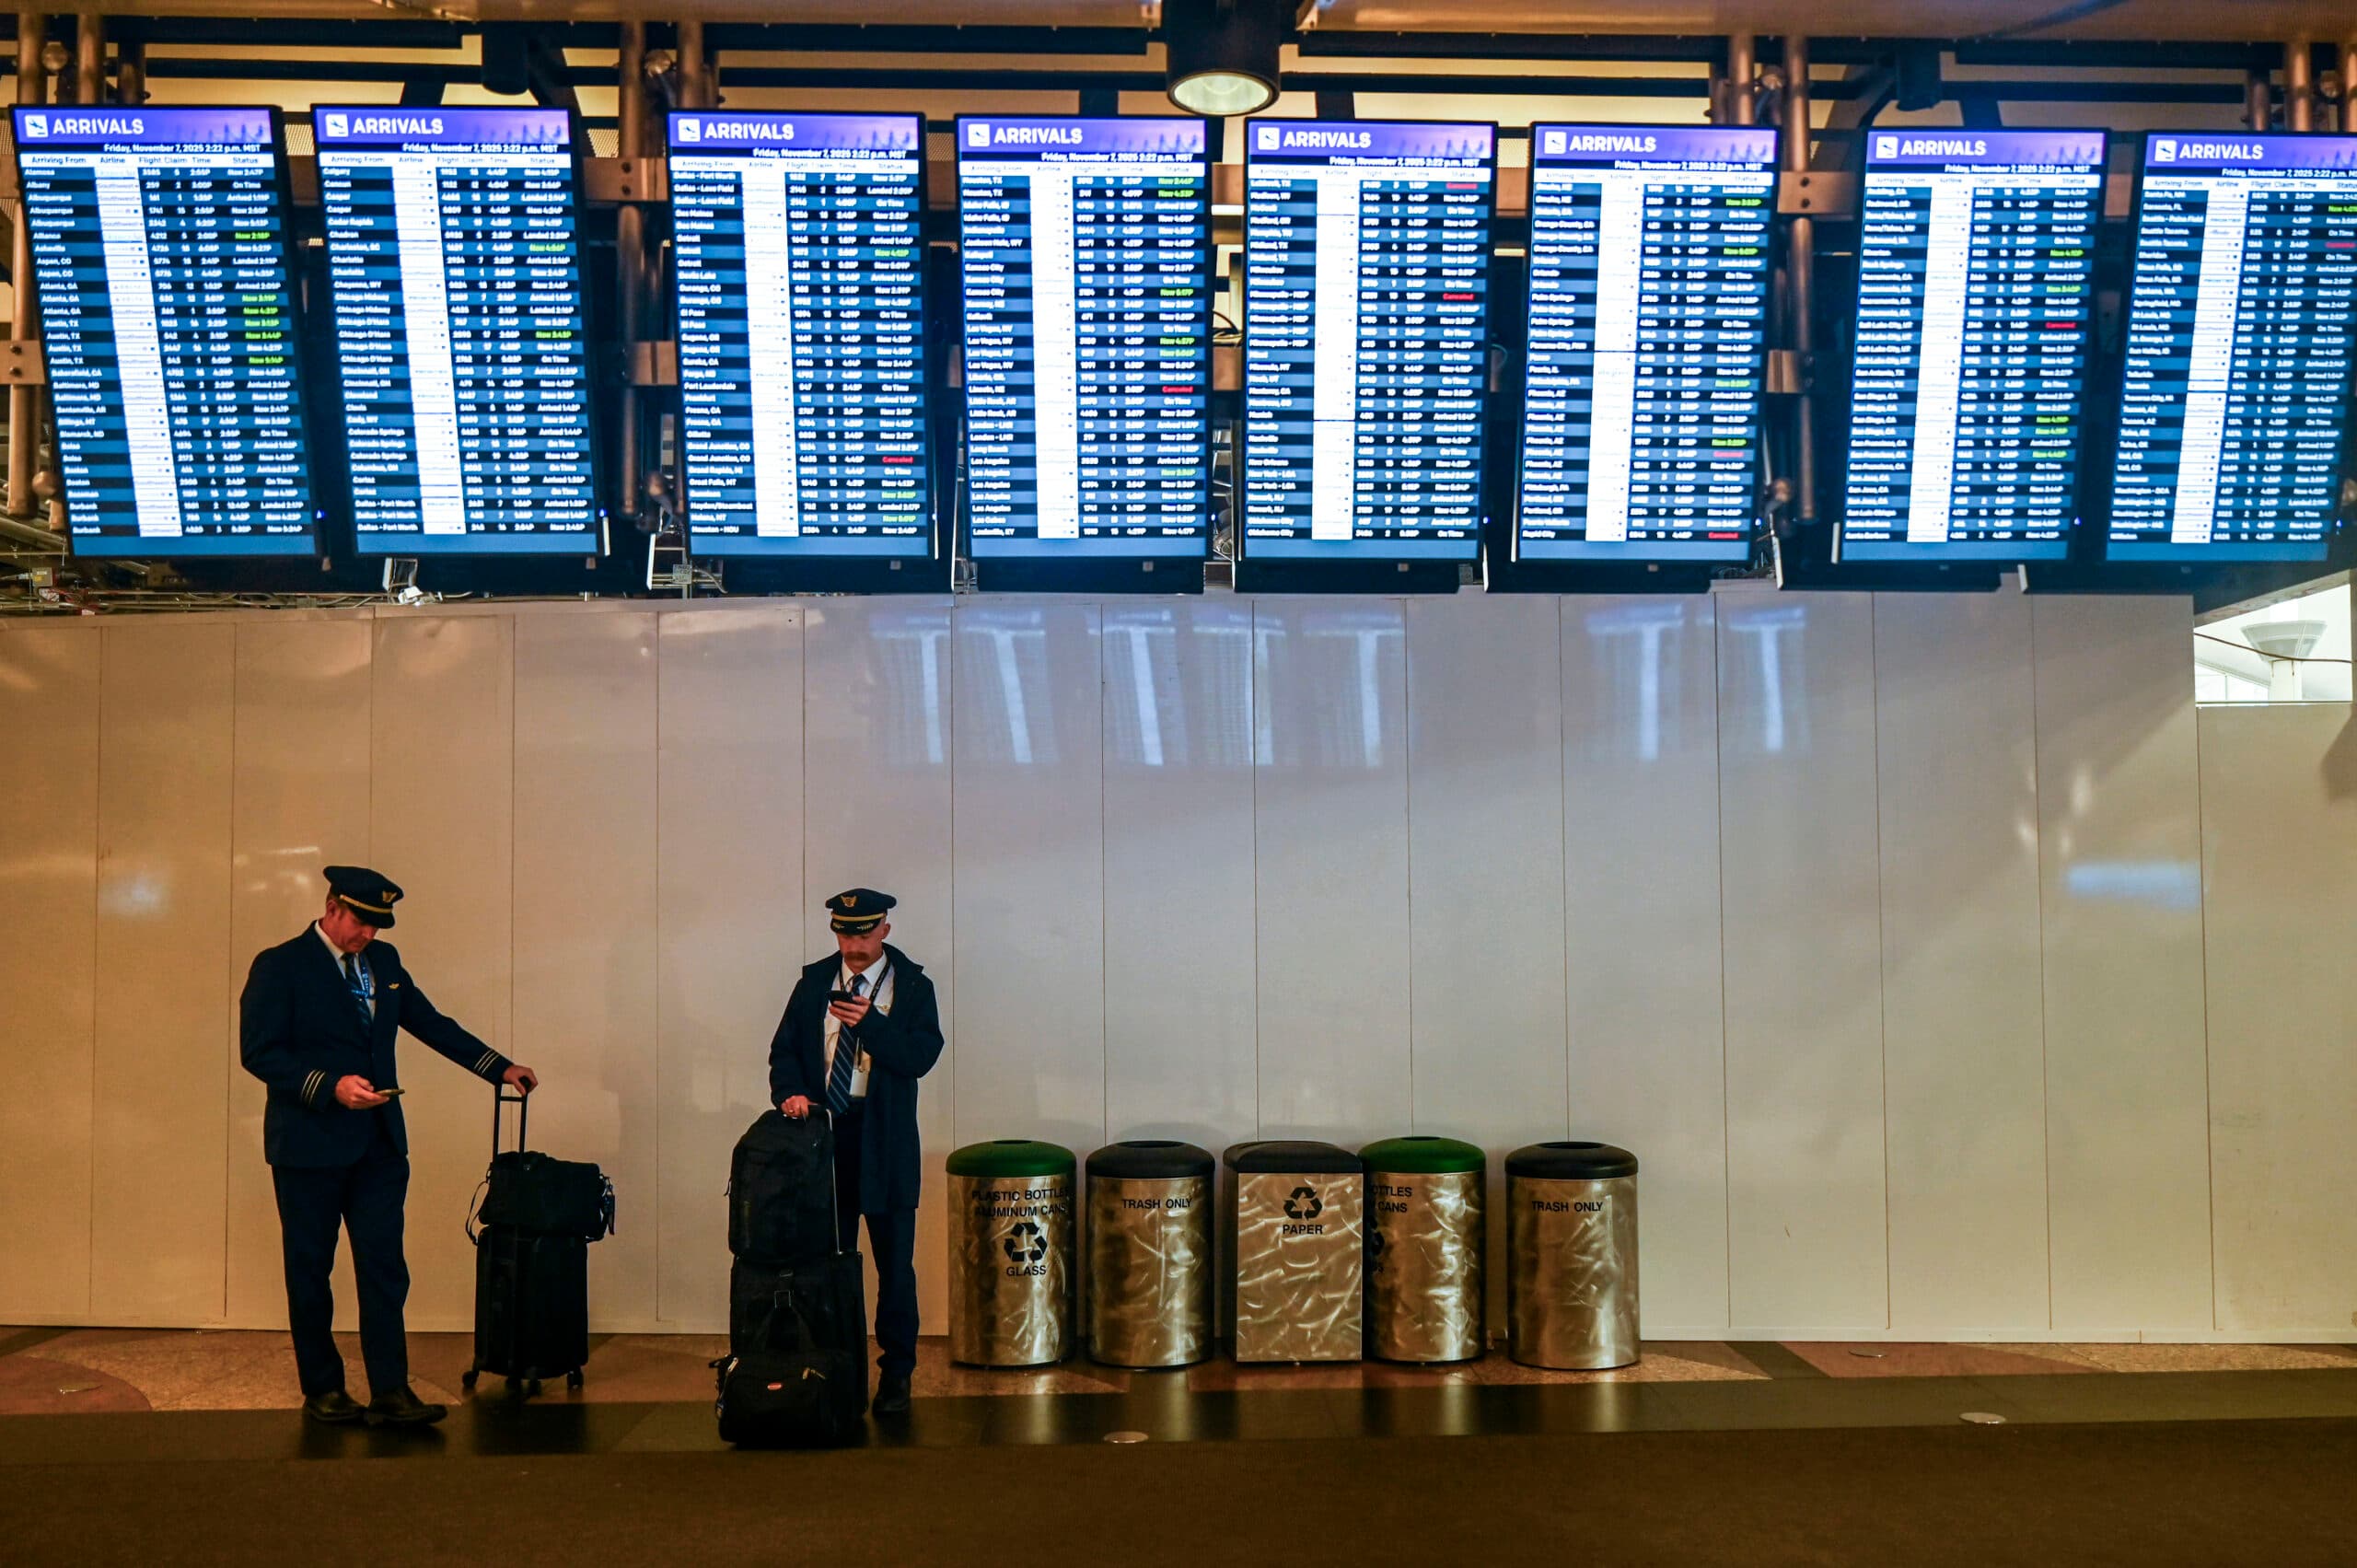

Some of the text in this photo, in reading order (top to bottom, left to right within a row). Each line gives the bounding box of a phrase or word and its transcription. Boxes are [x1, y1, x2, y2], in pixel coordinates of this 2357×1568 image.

[53, 119, 144, 134] ARRIVALS
[353, 118, 443, 134] ARRIVALS
[705, 123, 794, 140] ARRIVALS
[994, 128, 1082, 144] ARRIVALS
[1283, 132, 1371, 148] ARRIVALS
[103, 144, 131, 153] Friday,
[1570, 136, 1656, 152] ARRIVALS
[1901, 140, 1986, 155] ARRIVALS
[2179, 144, 2263, 159] ARRIVALS
[31, 156, 63, 165] Arriving
[138, 156, 161, 165] Flight
[2221, 168, 2246, 177] Friday,
[2153, 180, 2182, 188] Arriving
[2250, 180, 2271, 188] Flight
[972, 1191, 1020, 1202] PLASTIC
[1371, 1185, 1412, 1197] OTTLES
[1122, 1197, 1192, 1209] TRASH ONLY
[1377, 1201, 1408, 1213] CANS
[1532, 1201, 1603, 1212] TRASH ONLY
[976, 1203, 1066, 1217] ALUMINUM CANS
[1282, 1225, 1323, 1235] PAPER
[1006, 1265, 1046, 1277] GLASS
